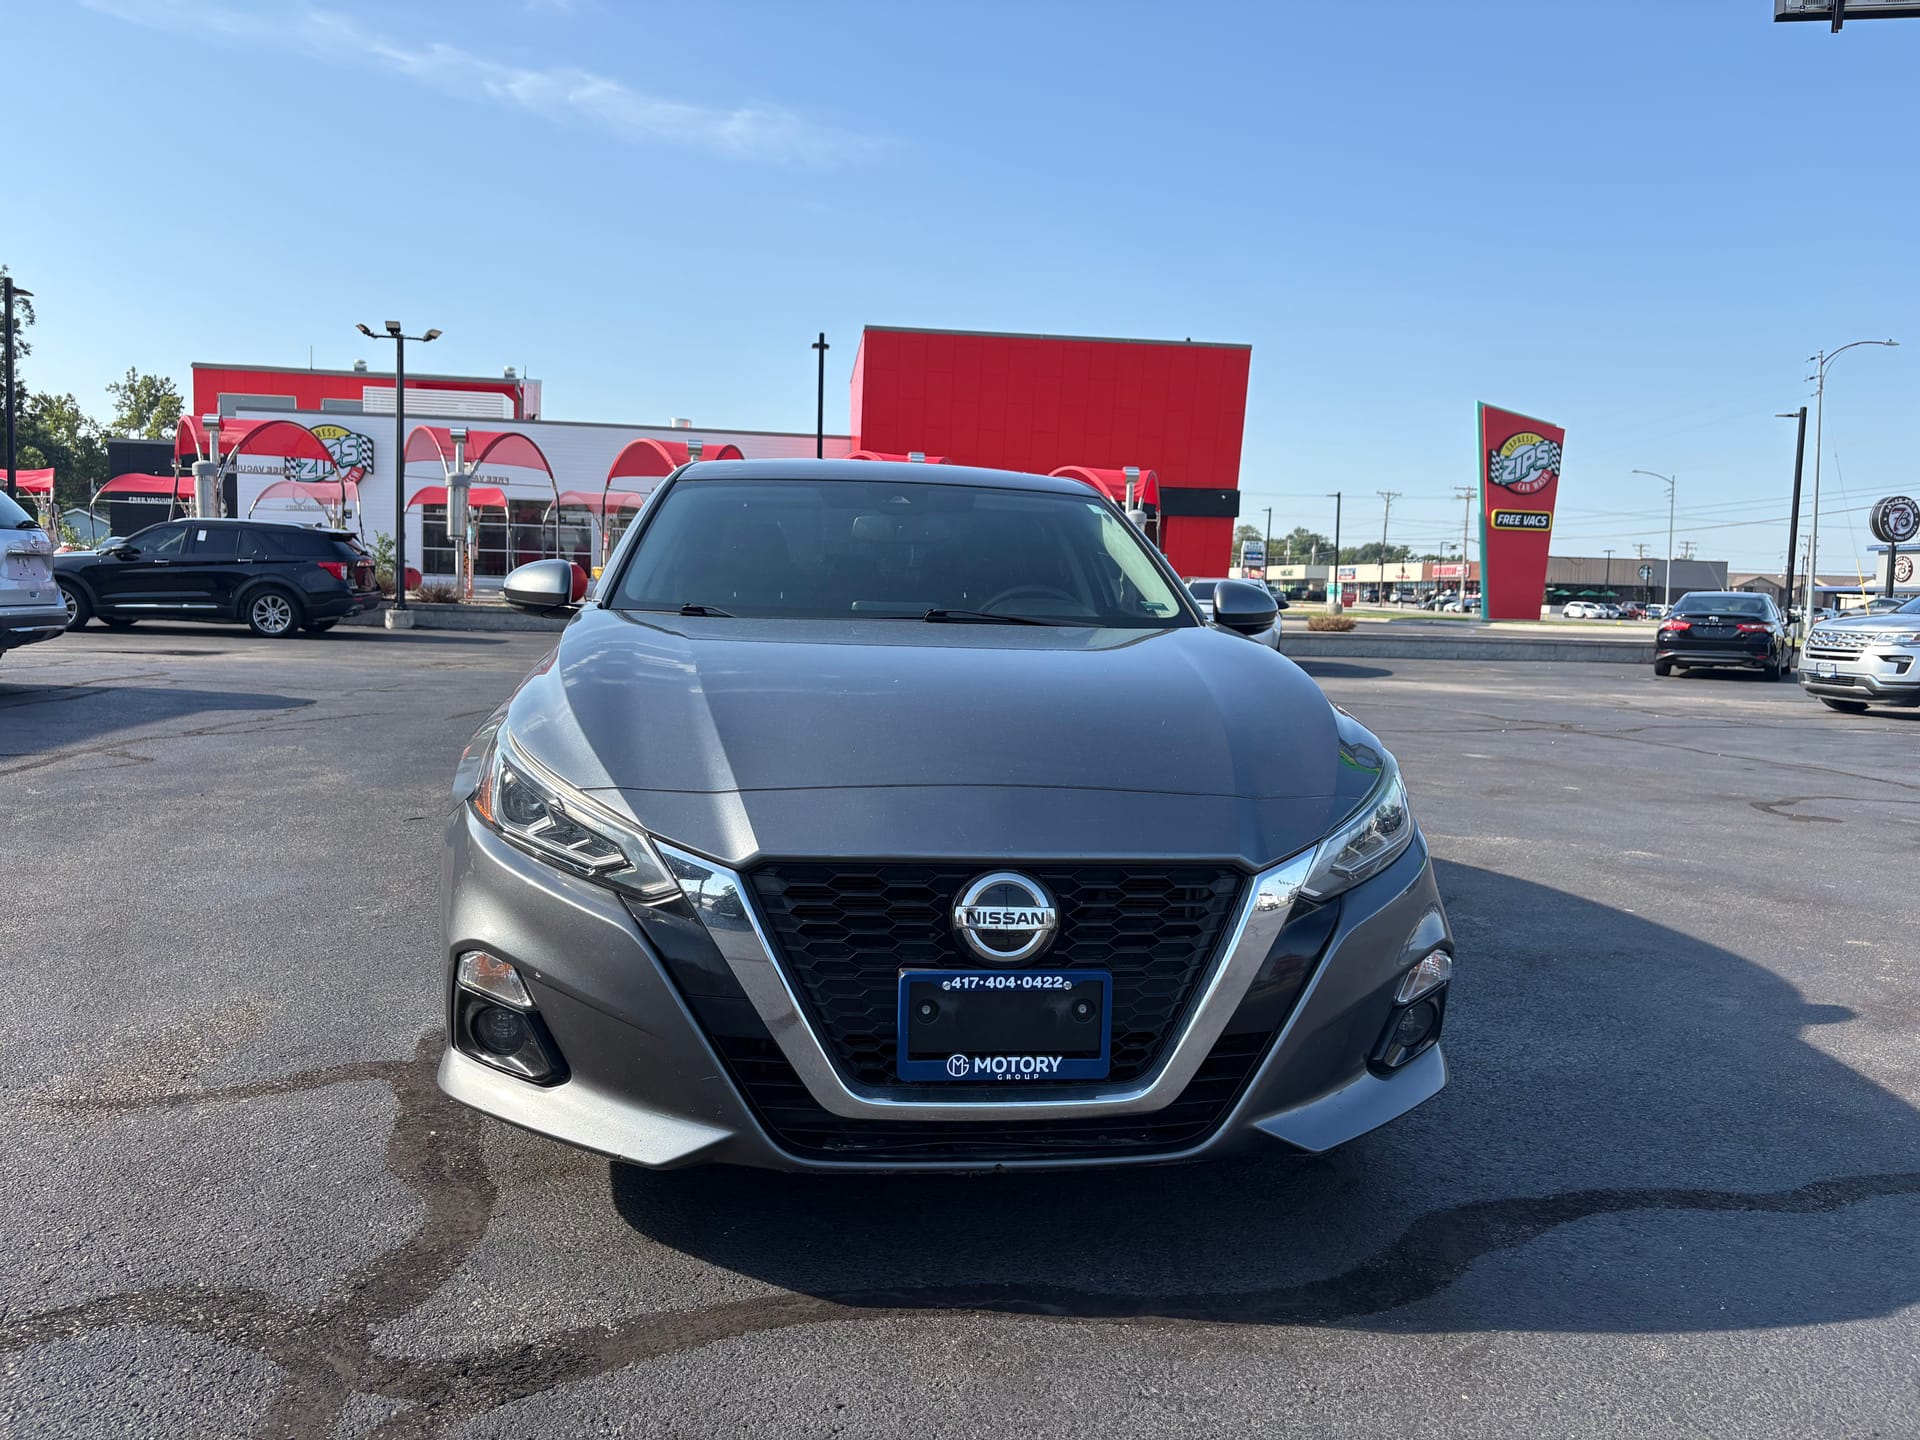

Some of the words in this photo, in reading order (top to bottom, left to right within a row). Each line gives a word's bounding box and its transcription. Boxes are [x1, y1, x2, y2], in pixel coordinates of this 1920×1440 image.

[1505, 434, 1534, 451] EXPRESS
[1501, 443, 1550, 481] ZIPS
[1517, 482, 1531, 492] CAR
[1533, 472, 1551, 490] WASH
[1496, 514, 1522, 525] FREE
[1523, 515, 1548, 527] VACS
[965, 911, 1046, 925] NISSAN
[974, 1056, 1063, 1073] MOTORY
[997, 1073, 1040, 1081] GROUP
